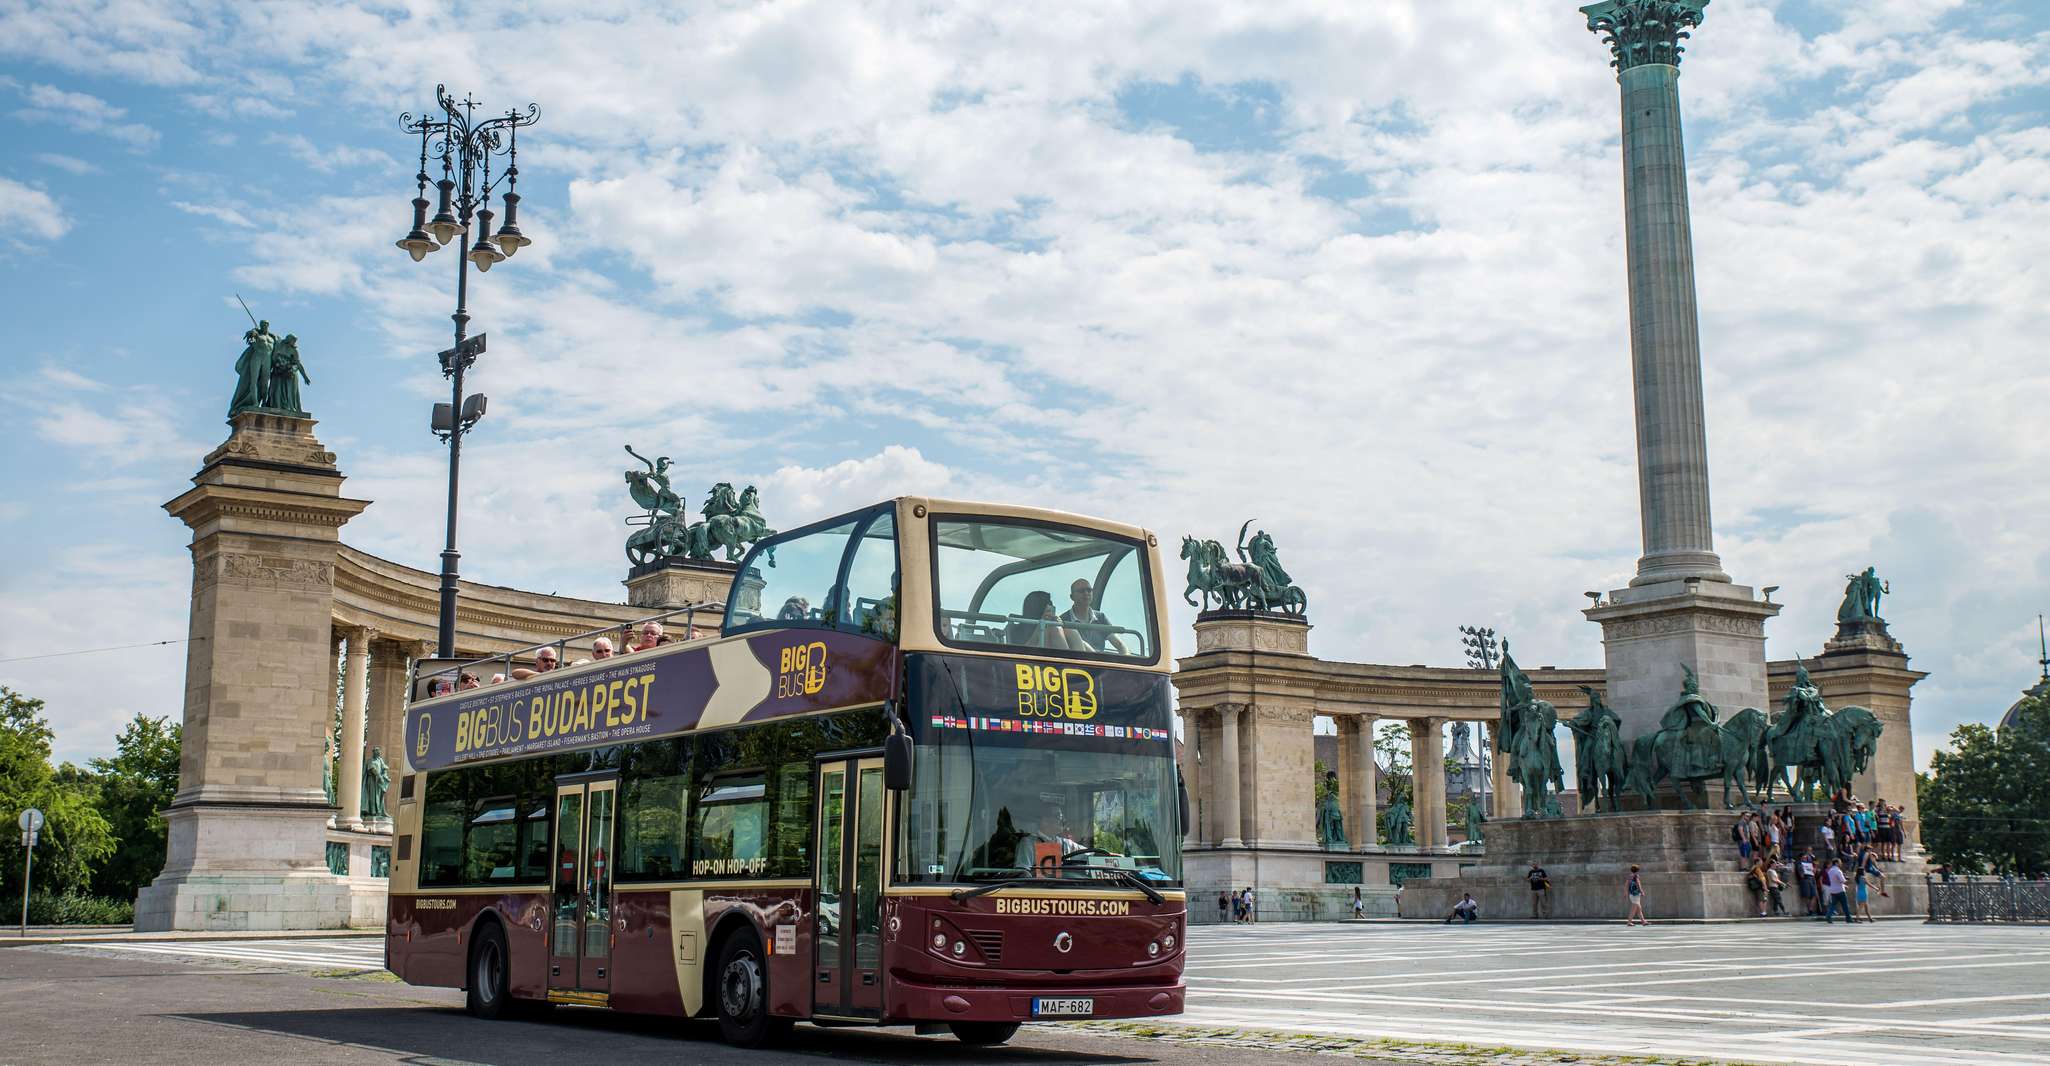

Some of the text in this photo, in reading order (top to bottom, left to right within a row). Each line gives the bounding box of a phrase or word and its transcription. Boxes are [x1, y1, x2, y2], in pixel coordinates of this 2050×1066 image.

[780, 645, 807, 673] BIG
[514, 688, 531, 699] BASILICA
[541, 684, 554, 692] ROYAL
[554, 680, 570, 690] PALACE
[572, 677, 589, 687] HEROES
[589, 673, 606, 684] SQUARE
[608, 671, 617, 679] THE
[617, 668, 630, 677] MAIN
[630, 662, 657, 675] SYNAGOGUE
[778, 672, 805, 699] BUS
[1015, 664, 1061, 692] BIG
[455, 673, 656, 753] BIGBUS BUDAPEST
[1018, 691, 1064, 718] BUS
[526, 740, 546, 751] MARGARET
[547, 738, 561, 748] ISLAND
[563, 734, 591, 745] FISHERMAN'S
[591, 731, 609, 742] BASTION
[612, 729, 621, 737] THE
[621, 726, 636, 737] OPERA
[635, 724, 652, 734] HOUSE
[692, 857, 767, 876] HOP-ON HOP-OFF
[996, 898, 1129, 916] BIGBUSTOURS.COM
[1041, 1000, 1091, 1013] MAF-682
